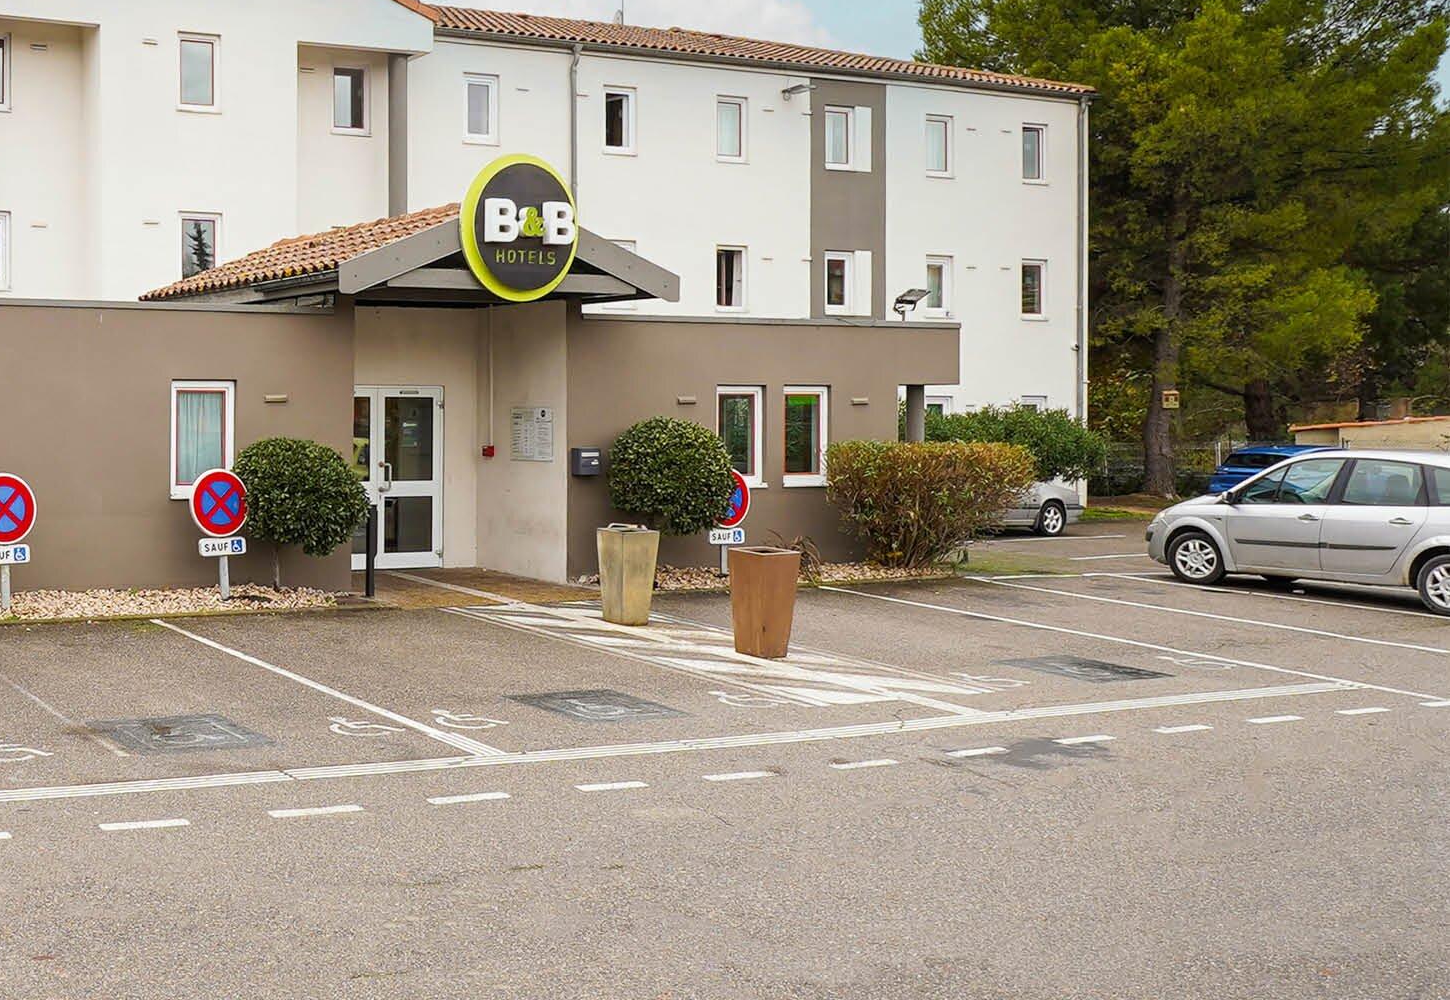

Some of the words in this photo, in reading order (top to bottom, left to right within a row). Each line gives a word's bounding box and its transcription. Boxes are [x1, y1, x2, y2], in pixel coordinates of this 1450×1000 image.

[484, 197, 576, 245] B&B
[495, 249, 557, 265] HOTELS
[712, 532, 732, 541] SAUF
[204, 541, 229, 553] SAUF
